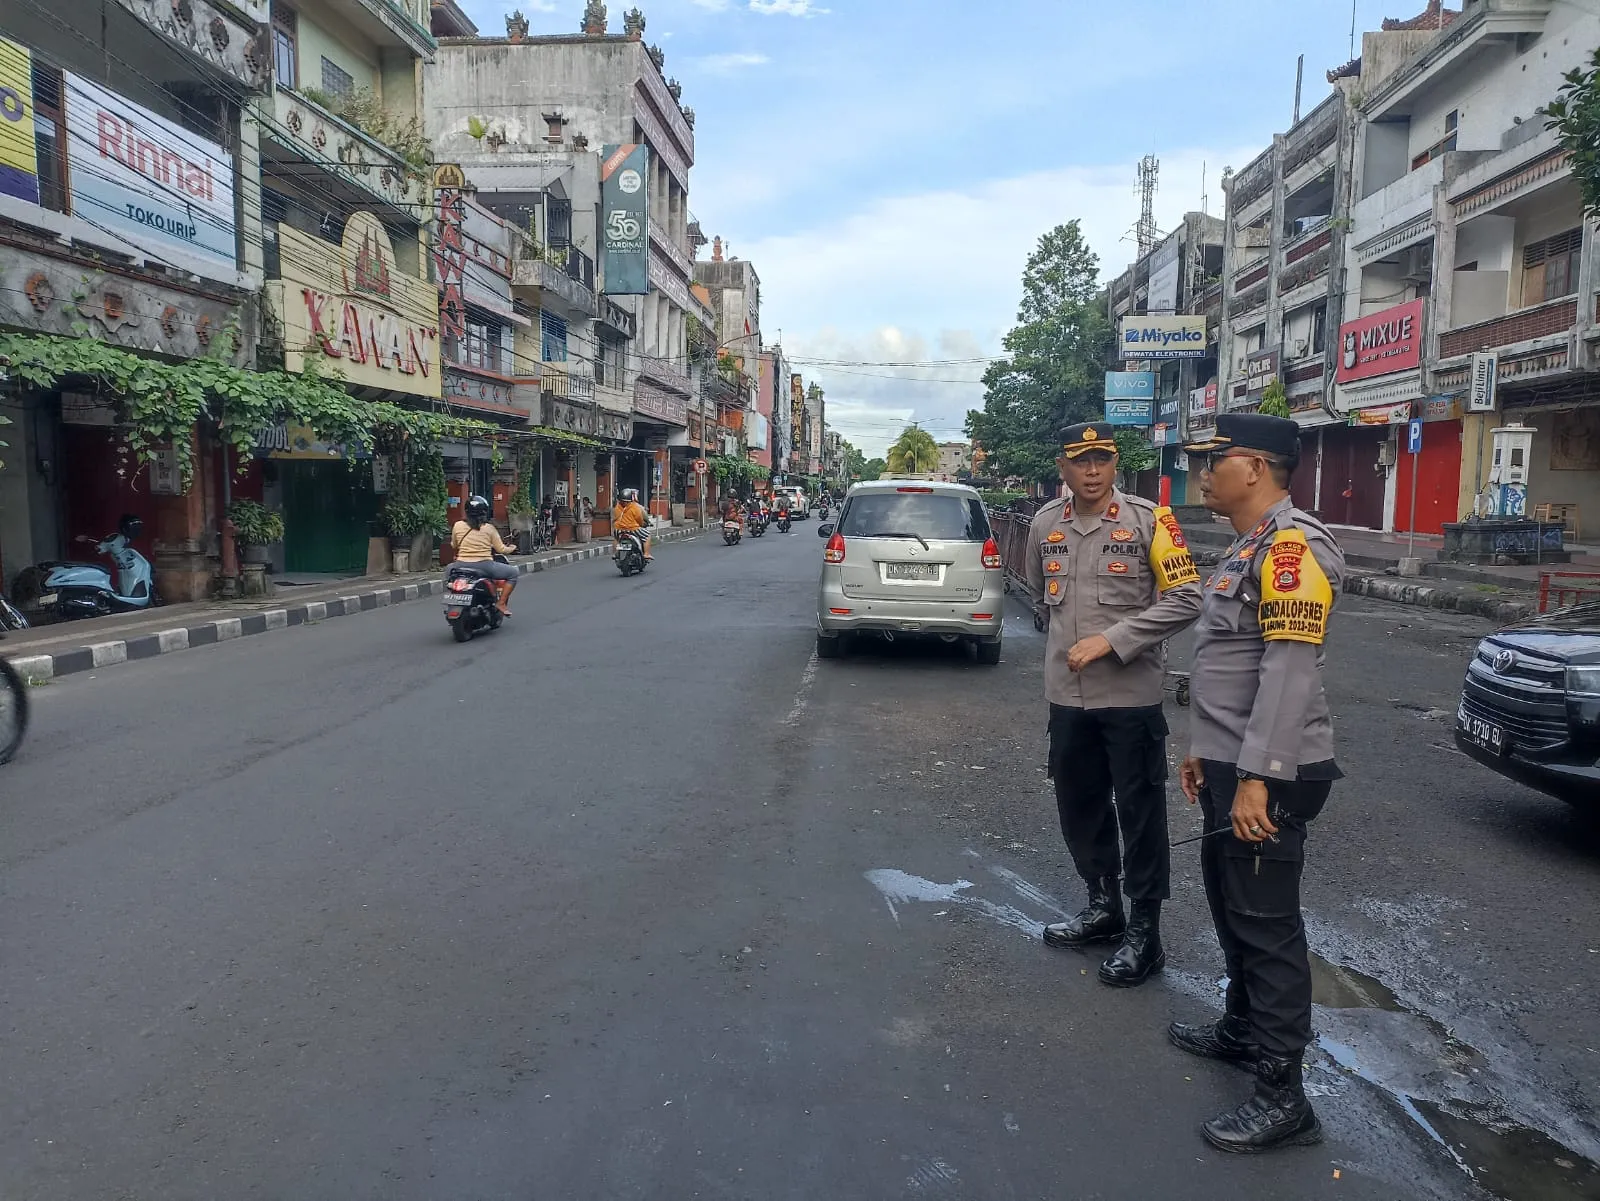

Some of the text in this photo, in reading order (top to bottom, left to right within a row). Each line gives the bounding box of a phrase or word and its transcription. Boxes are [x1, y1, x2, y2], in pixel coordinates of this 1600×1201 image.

[96, 107, 214, 202] Rinnai
[126, 203, 197, 240] TOKO URIP
[433, 193, 467, 339] KAWAN
[301, 288, 436, 378] KAWAN
[1141, 327, 1203, 346] Miyako
[1360, 315, 1412, 352] MIXUE
[1110, 403, 1150, 412] ASUS
[1160, 400, 1179, 415] SAMSUN
[1410, 422, 1421, 450] P
[1042, 544, 1069, 554] SURYA
[1102, 544, 1138, 554] POLRI
[1274, 543, 1302, 551] POLRES
[888, 564, 899, 574] DK
[1472, 719, 1490, 740] 1710
